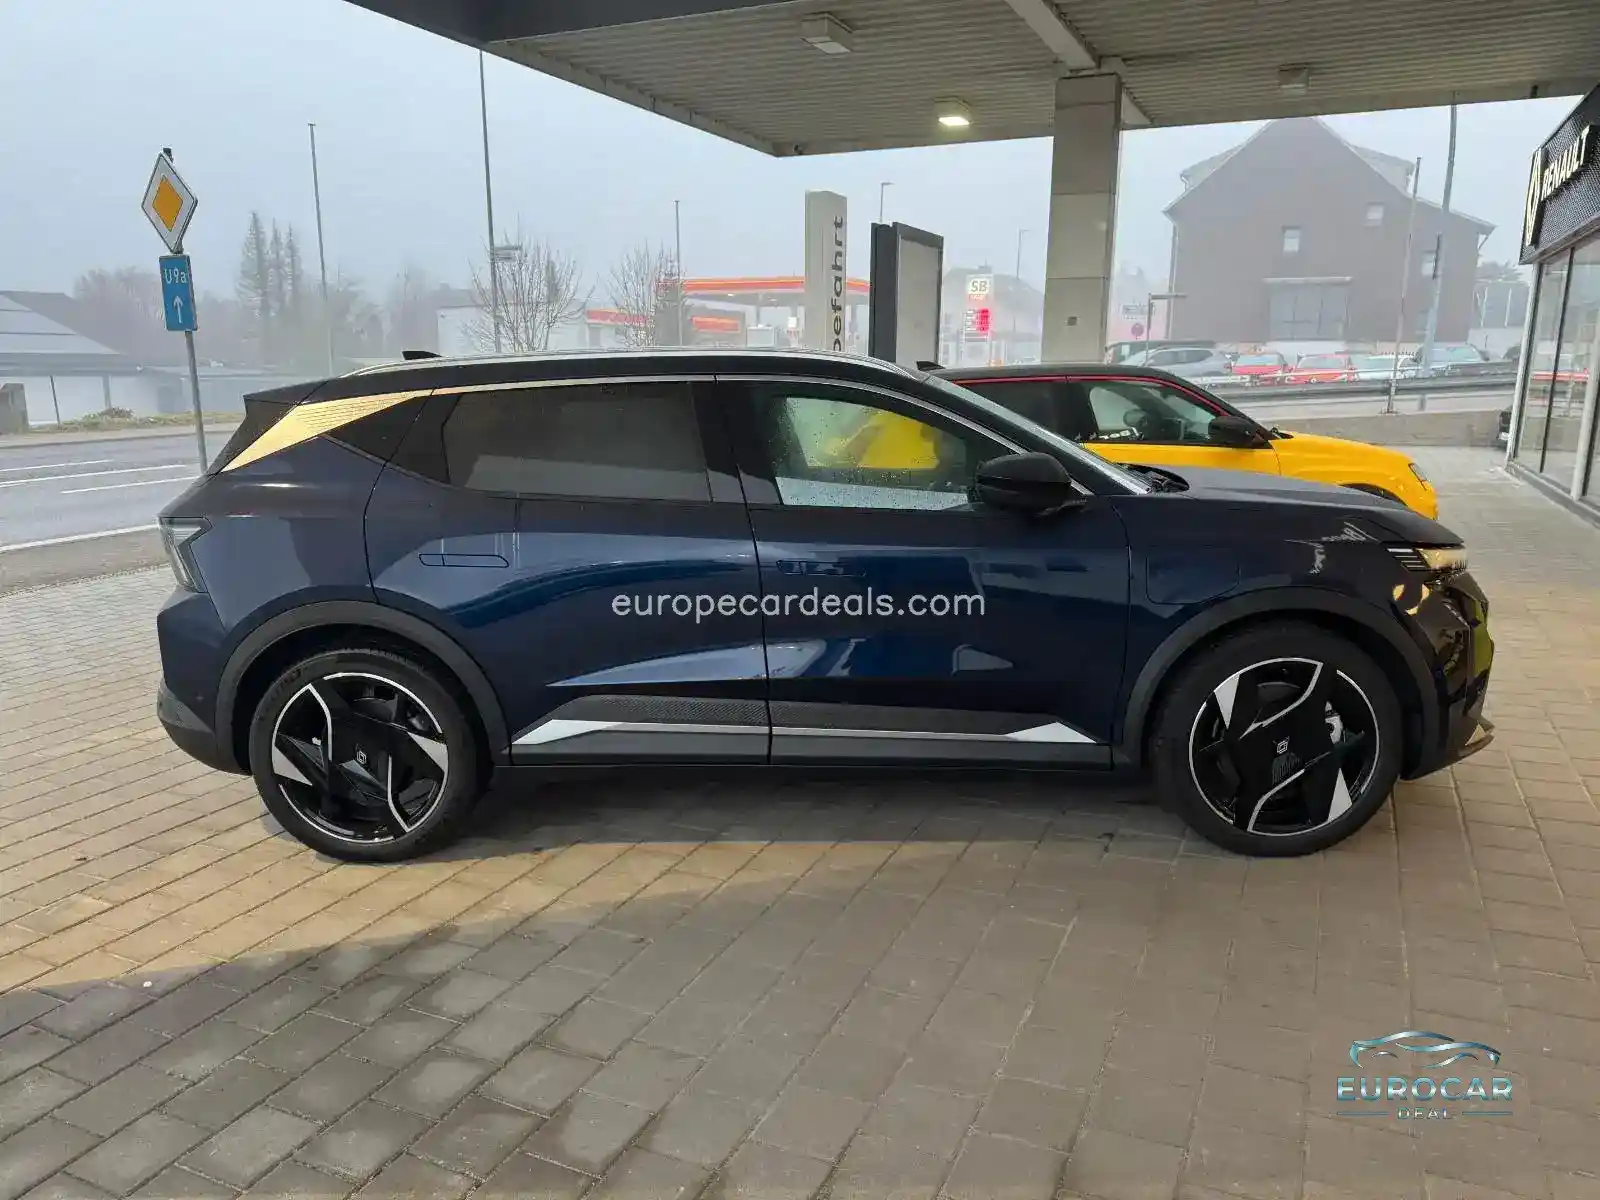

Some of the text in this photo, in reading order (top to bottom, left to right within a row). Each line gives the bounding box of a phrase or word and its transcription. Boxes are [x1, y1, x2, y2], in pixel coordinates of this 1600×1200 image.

[1541, 124, 1590, 201] RENAULT
[164, 268, 187, 284] U9a
[970, 280, 987, 292] SB
